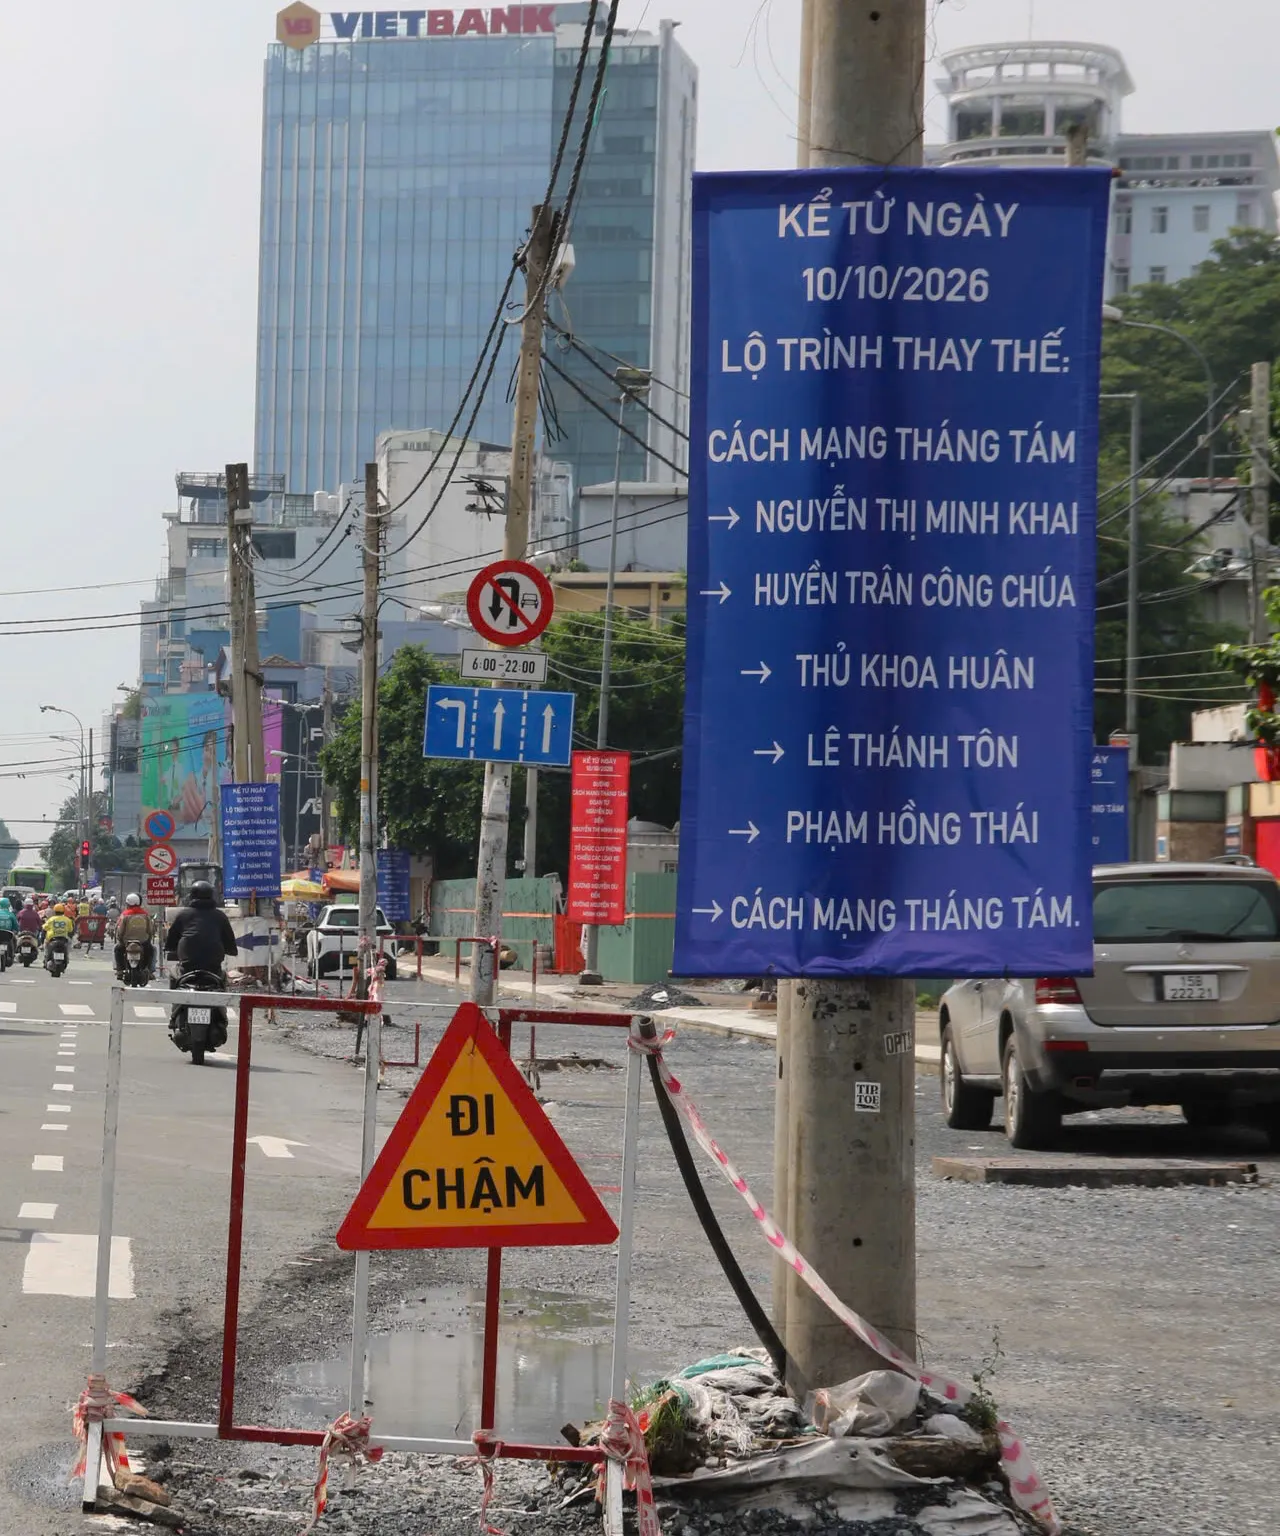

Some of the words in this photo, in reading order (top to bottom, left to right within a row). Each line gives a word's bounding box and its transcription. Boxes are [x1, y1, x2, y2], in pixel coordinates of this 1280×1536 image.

[331, 6, 556, 38] VIETBANK
[778, 187, 833, 237] KỂ
[842, 191, 896, 235] TỪ
[907, 193, 1019, 238] NGÀY
[802, 265, 990, 302] 10/10/2026
[722, 331, 766, 380] LỘ
[777, 327, 882, 372] TRÌNH
[892, 336, 982, 372] THAY
[992, 327, 1069, 373] THẾ:
[708, 419, 789, 463] CÁCH
[800, 426, 887, 467] MẠNG
[895, 419, 1000, 463] THÁNG
[1009, 421, 1075, 463] TÁM
[756, 484, 867, 533] NGUYỄN
[876, 497, 916, 541] THỊ
[926, 501, 998, 534] MINH
[1009, 501, 1078, 534] KHAI
[754, 559, 837, 606] HUYỀN
[845, 564, 912, 606] TRÂN
[921, 566, 993, 607] CÔNG
[1002, 566, 1076, 608] CHÚA
[796, 641, 849, 687] THỦ
[860, 655, 938, 688] KHOA
[948, 649, 1034, 689] HUÂN
[807, 725, 841, 767] LÊ
[848, 725, 948, 768] THÁNH
[958, 728, 1018, 768] TÔN
[786, 810, 868, 851] PHẠM
[878, 799, 961, 845] HỒNG
[970, 802, 1038, 844] THÁI
[730, 887, 804, 930] CÁCH
[813, 898, 896, 939] MẠNG
[904, 889, 1003, 931] THÁNG
[1012, 888, 1080, 928] TÁM.
[446, 1094, 495, 1136] ĐI
[856, 1095, 879, 1104] TOE
[402, 1157, 545, 1213] CHẬM
